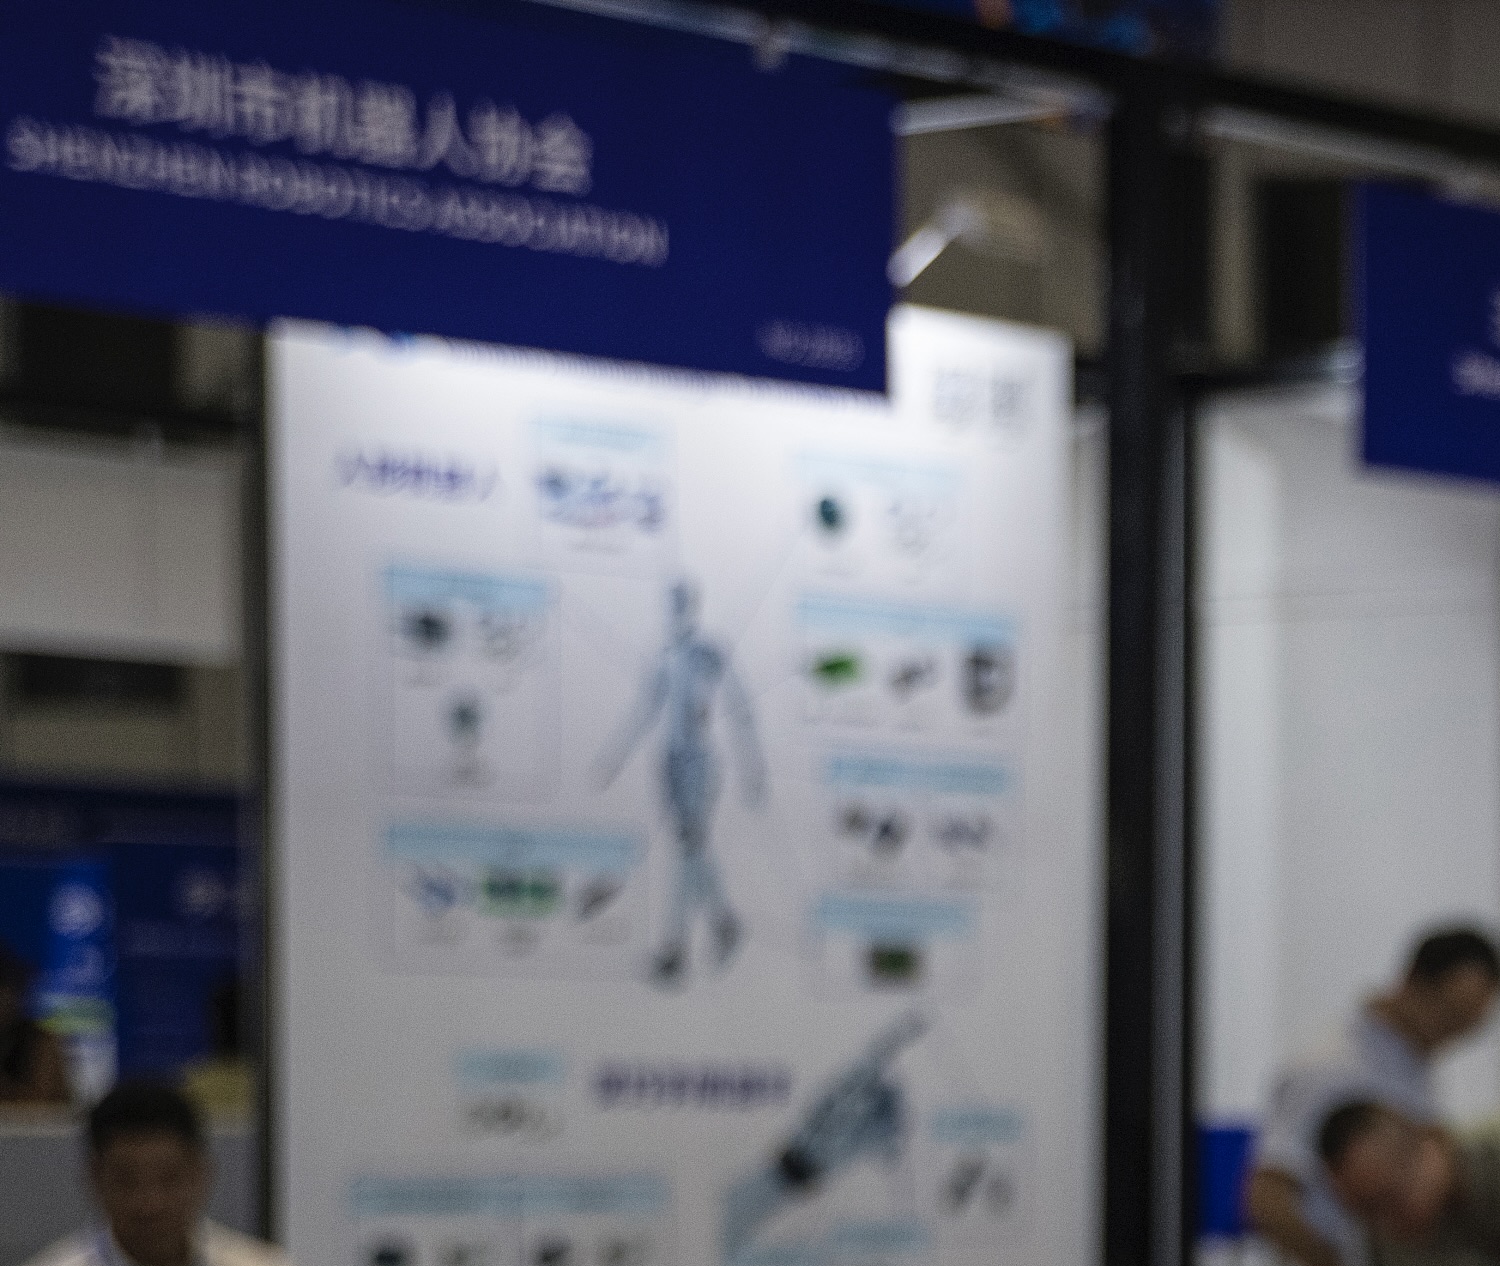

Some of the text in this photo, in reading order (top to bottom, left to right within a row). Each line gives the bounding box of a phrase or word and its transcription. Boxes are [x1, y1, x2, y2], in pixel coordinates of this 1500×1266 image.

[93, 35, 594, 195] 深圳市机器人协会
